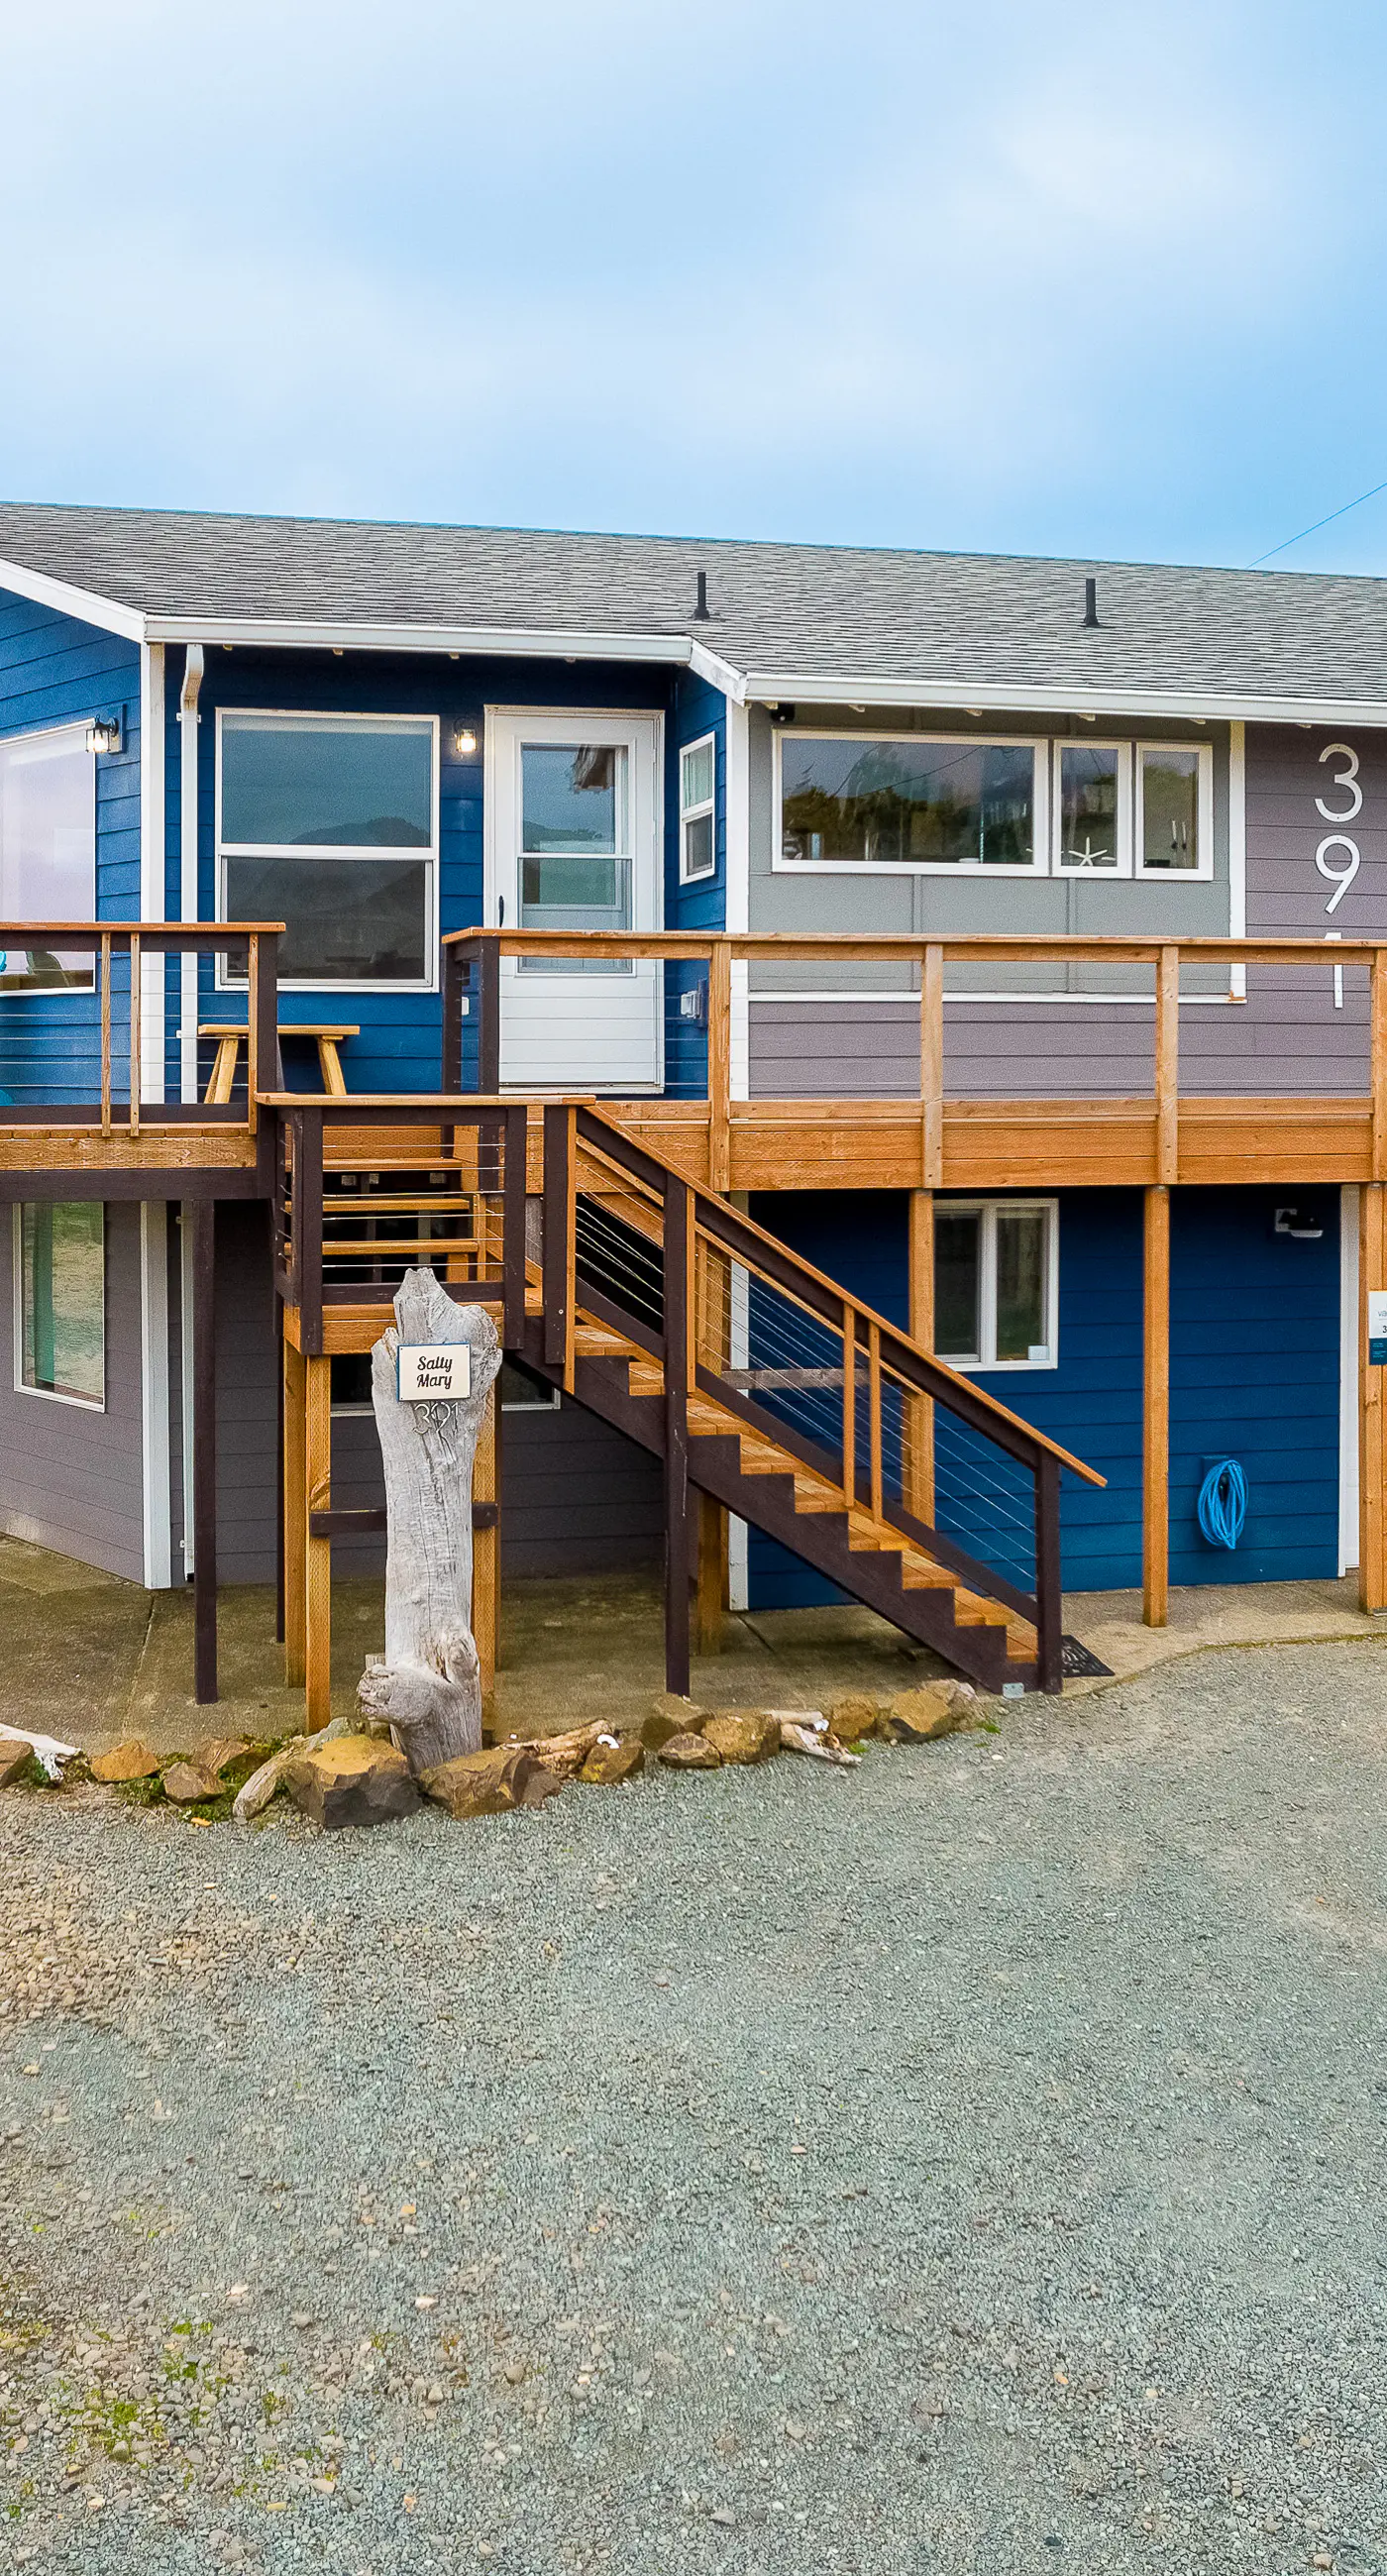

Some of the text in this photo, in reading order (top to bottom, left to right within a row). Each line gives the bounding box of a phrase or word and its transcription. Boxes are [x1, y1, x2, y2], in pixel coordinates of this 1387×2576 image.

[1315, 743, 1362, 1009] 391
[416, 1373, 453, 1390] Mary
[412, 1401, 459, 1437] 391
